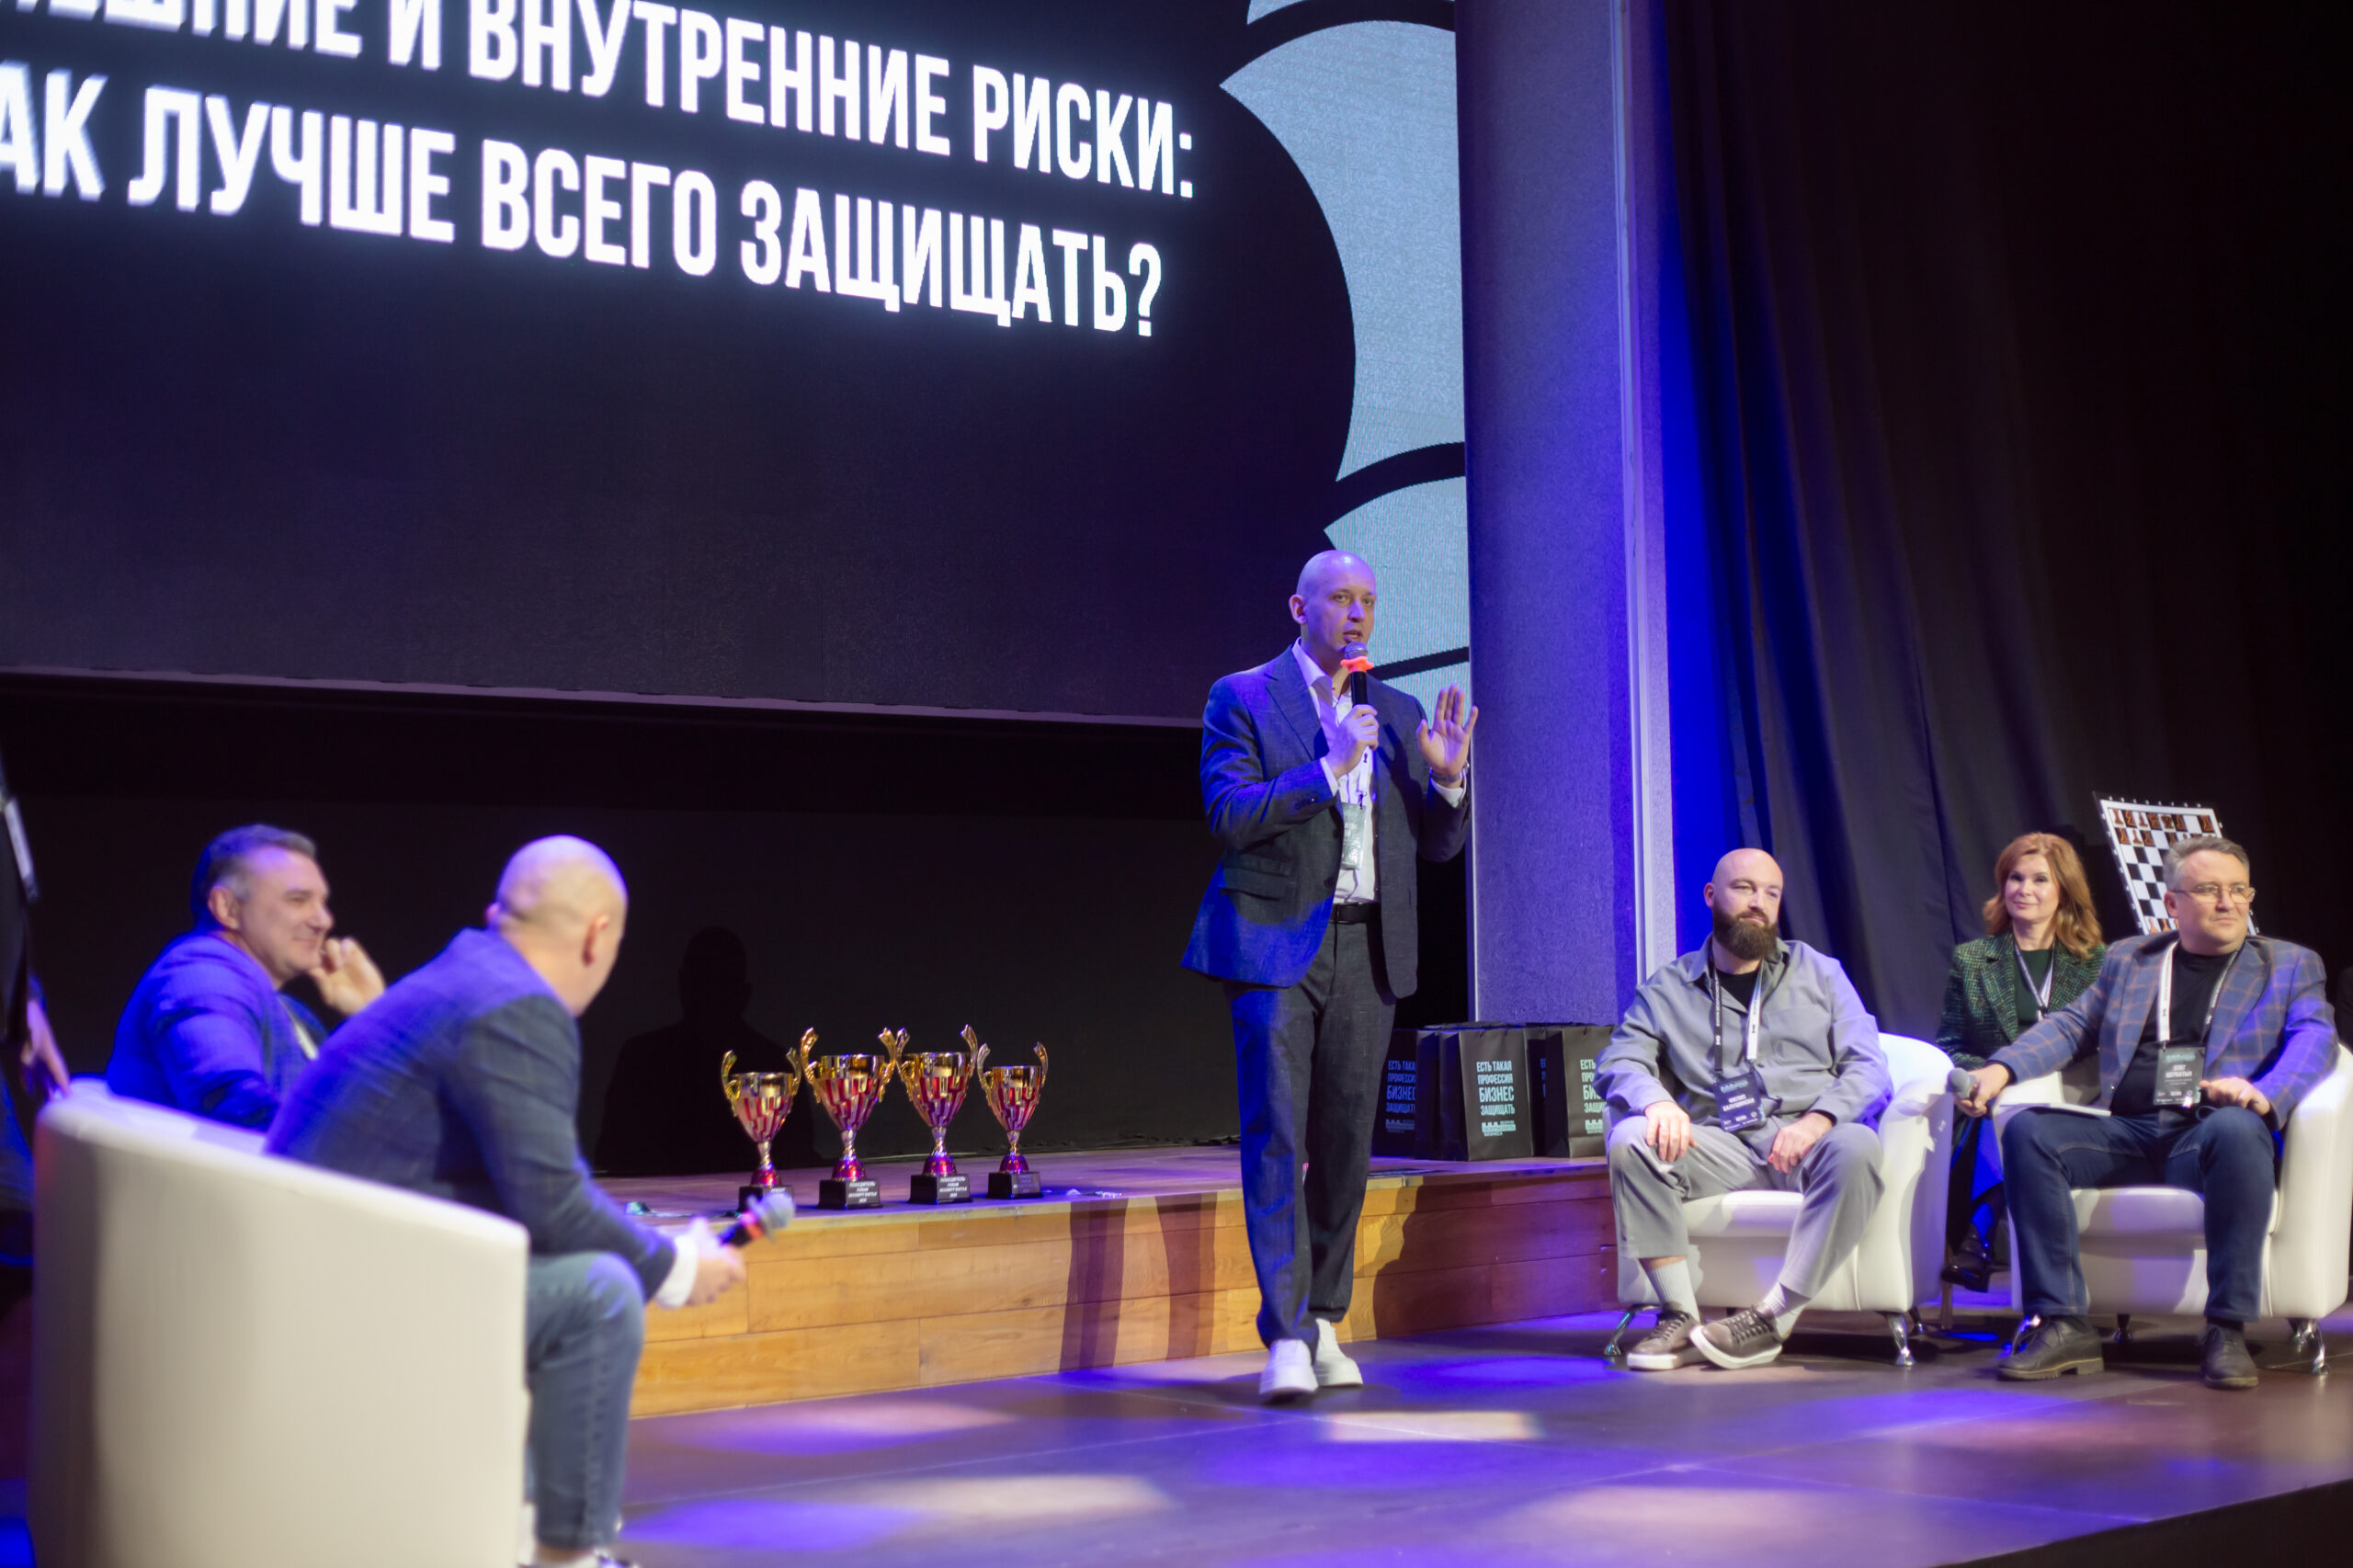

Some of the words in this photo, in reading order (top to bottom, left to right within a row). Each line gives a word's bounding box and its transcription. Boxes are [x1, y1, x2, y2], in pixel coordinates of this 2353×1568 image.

[388, 0, 443, 71] И
[469, 0, 950, 156] ВНУТРЕННИЕ
[972, 64, 1193, 199] РИСКИ:
[0, 61, 108, 200] АК
[128, 85, 456, 244] ЛУЧШЕ
[481, 139, 717, 277] ВСЕГО
[740, 179, 1162, 337] ЗАЩИЩАТЬ?
[1388, 1060, 1402, 1072] ЕСТЬ
[1402, 1060, 1416, 1072] ТАКА
[1476, 1061, 1493, 1073] ЕСТЬ
[1493, 1060, 1513, 1072] ТАКАЯ
[1580, 1059, 1597, 1071] ЕСТЬ
[1387, 1073, 1416, 1084] ПРОФЕССИ
[1477, 1073, 1514, 1085] ПРОФЕССИЯ
[1478, 1085, 1515, 1103] БИЗНЕС
[1480, 1103, 1516, 1117] ЗАЩИЩАТЬ
